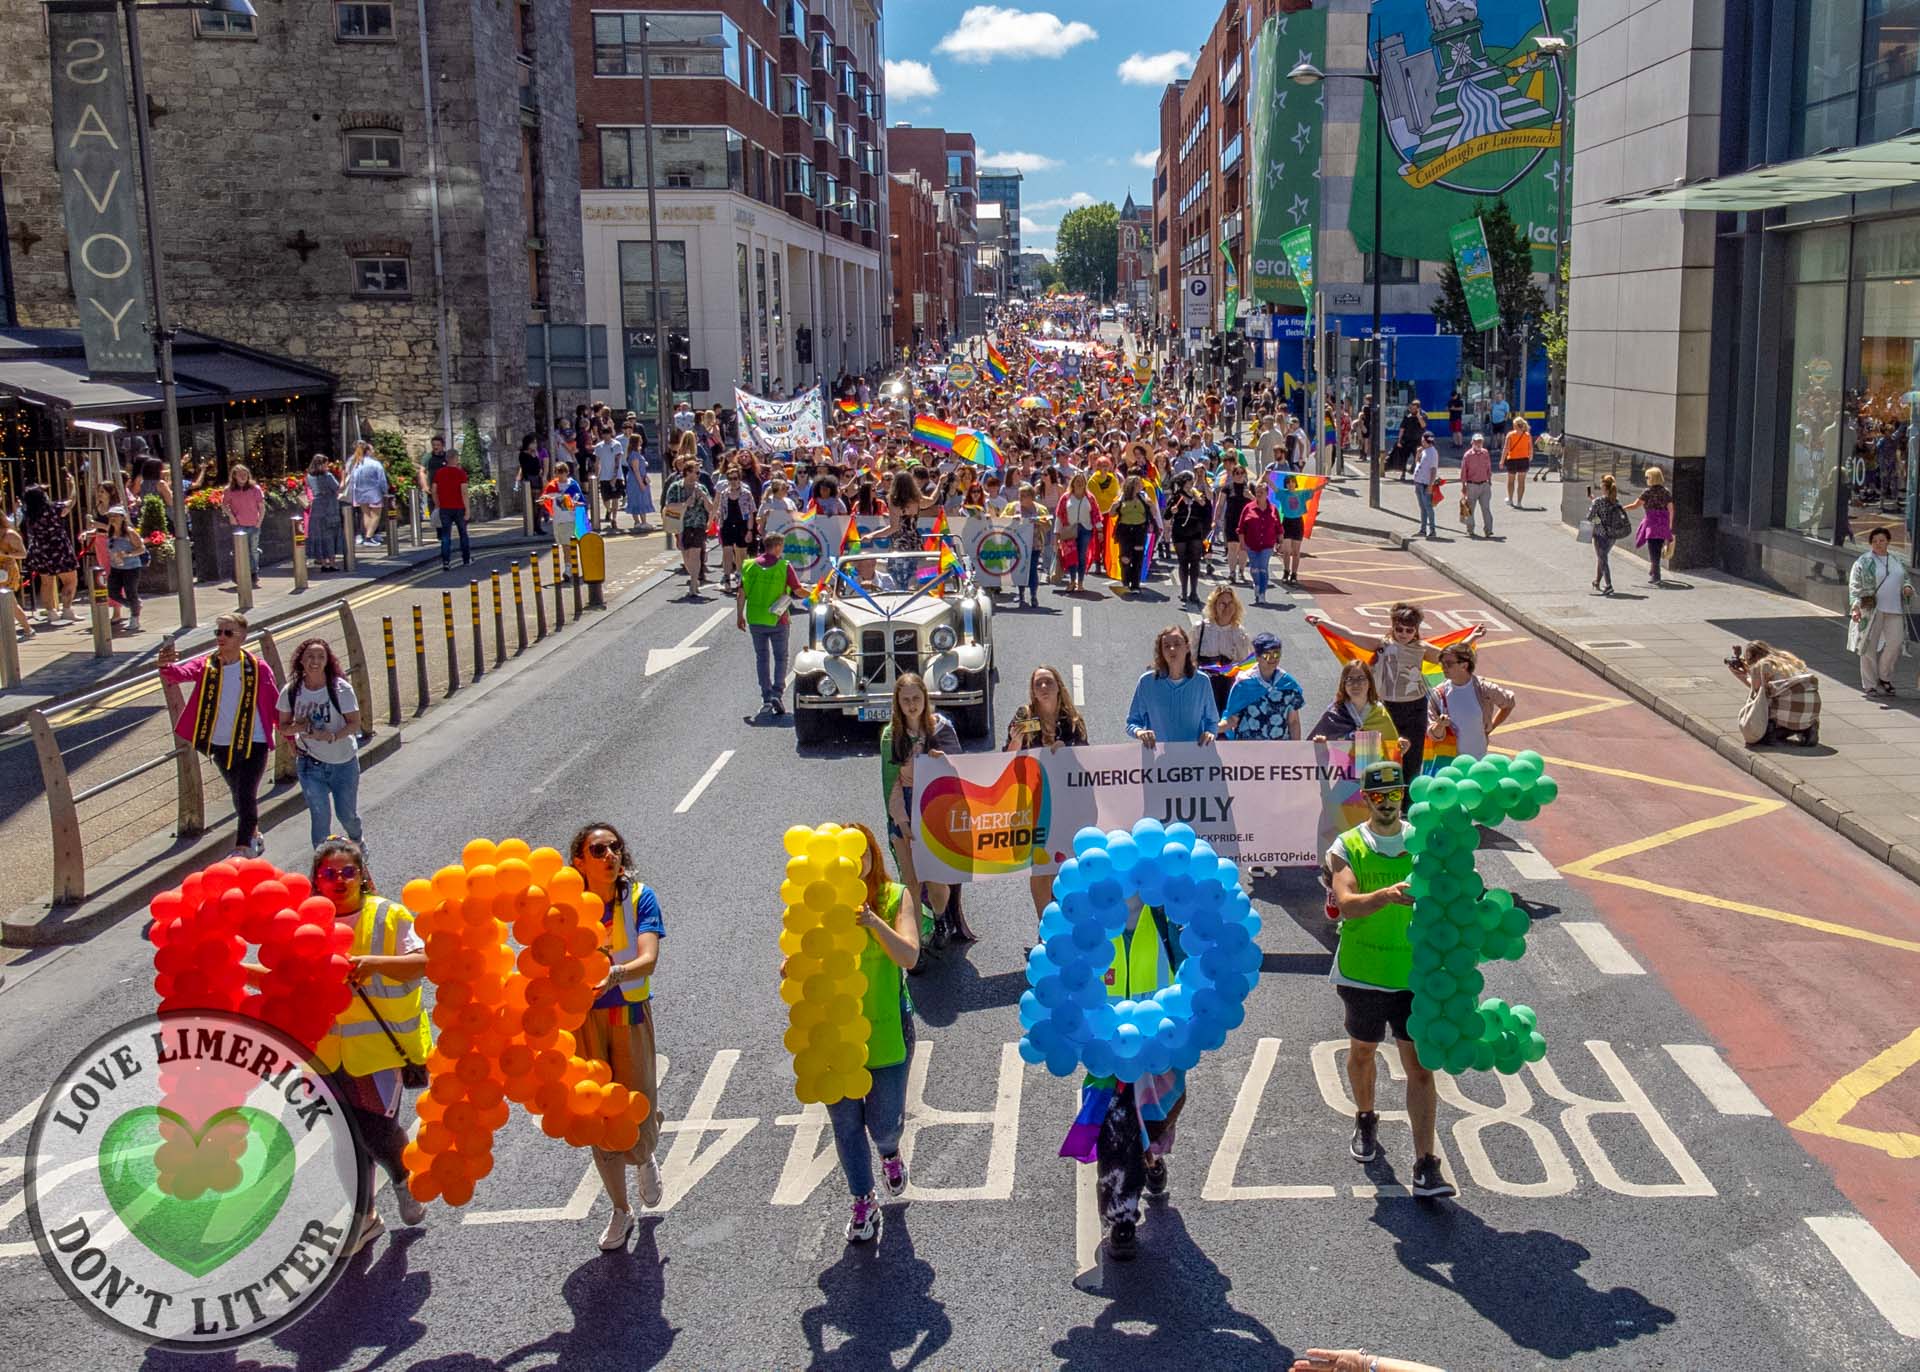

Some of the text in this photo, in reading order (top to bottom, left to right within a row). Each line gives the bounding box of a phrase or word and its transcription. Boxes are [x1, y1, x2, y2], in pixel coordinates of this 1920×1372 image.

[1415, 132, 1556, 184] Cuimhnigh ar Luimneach
[662, 205, 716, 221] HOUSE
[1067, 765, 1357, 787] LIMERICK LGBT PRIDE FESTIVAL
[1160, 796, 1235, 823] JULY
[977, 827, 1046, 850] PRIDE
[1202, 1037, 1718, 1201] R857
